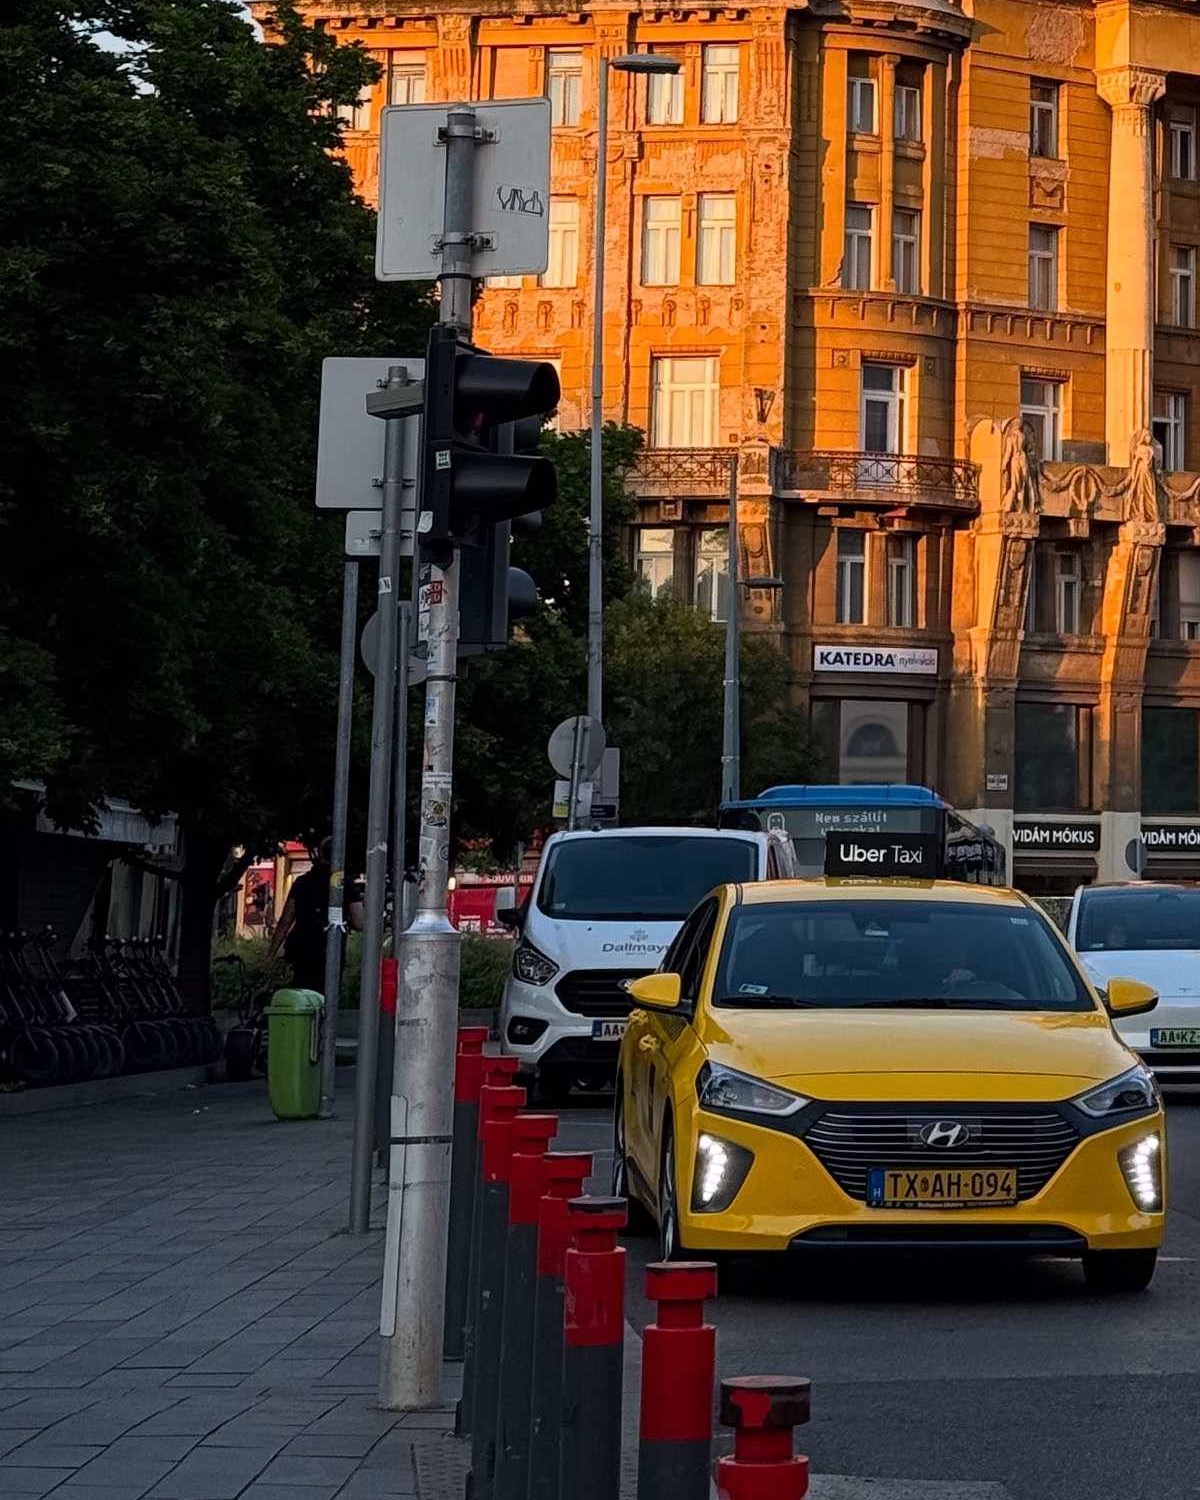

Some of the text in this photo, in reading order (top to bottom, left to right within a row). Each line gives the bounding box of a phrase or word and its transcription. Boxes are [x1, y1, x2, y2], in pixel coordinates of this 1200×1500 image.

[820, 651, 895, 667] KATEDRA
[815, 810, 887, 823] Nem szállít
[1012, 826, 1095, 844] VIDÁM MÓKUS
[1140, 829, 1176, 845] VIDÁM
[840, 844, 923, 863] Uber Taxi
[484, 875, 533, 884] SOUVIR
[873, 1188, 881, 1197] H
